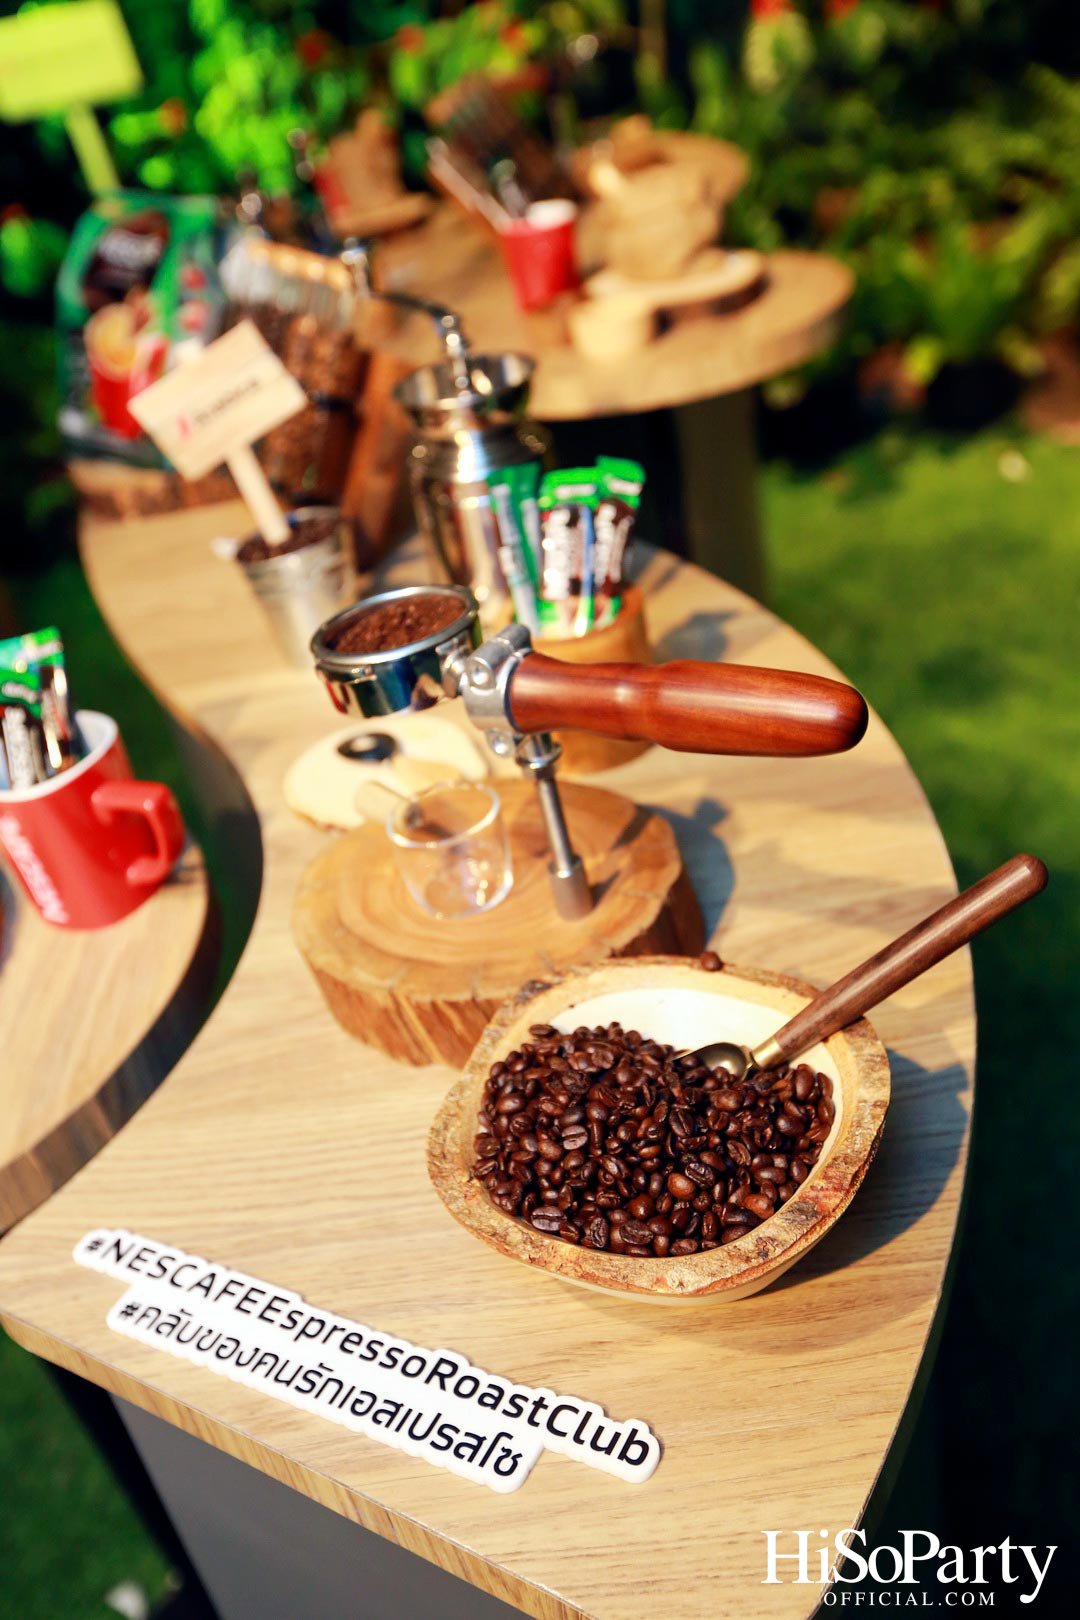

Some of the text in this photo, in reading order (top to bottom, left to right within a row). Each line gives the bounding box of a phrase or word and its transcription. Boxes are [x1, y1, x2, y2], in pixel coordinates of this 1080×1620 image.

[87, 1237, 651, 1466] #NESCAFEEspressoRoastClub
[119, 1301, 524, 1477] #คลับของคนรักเอสเปรสโซ
